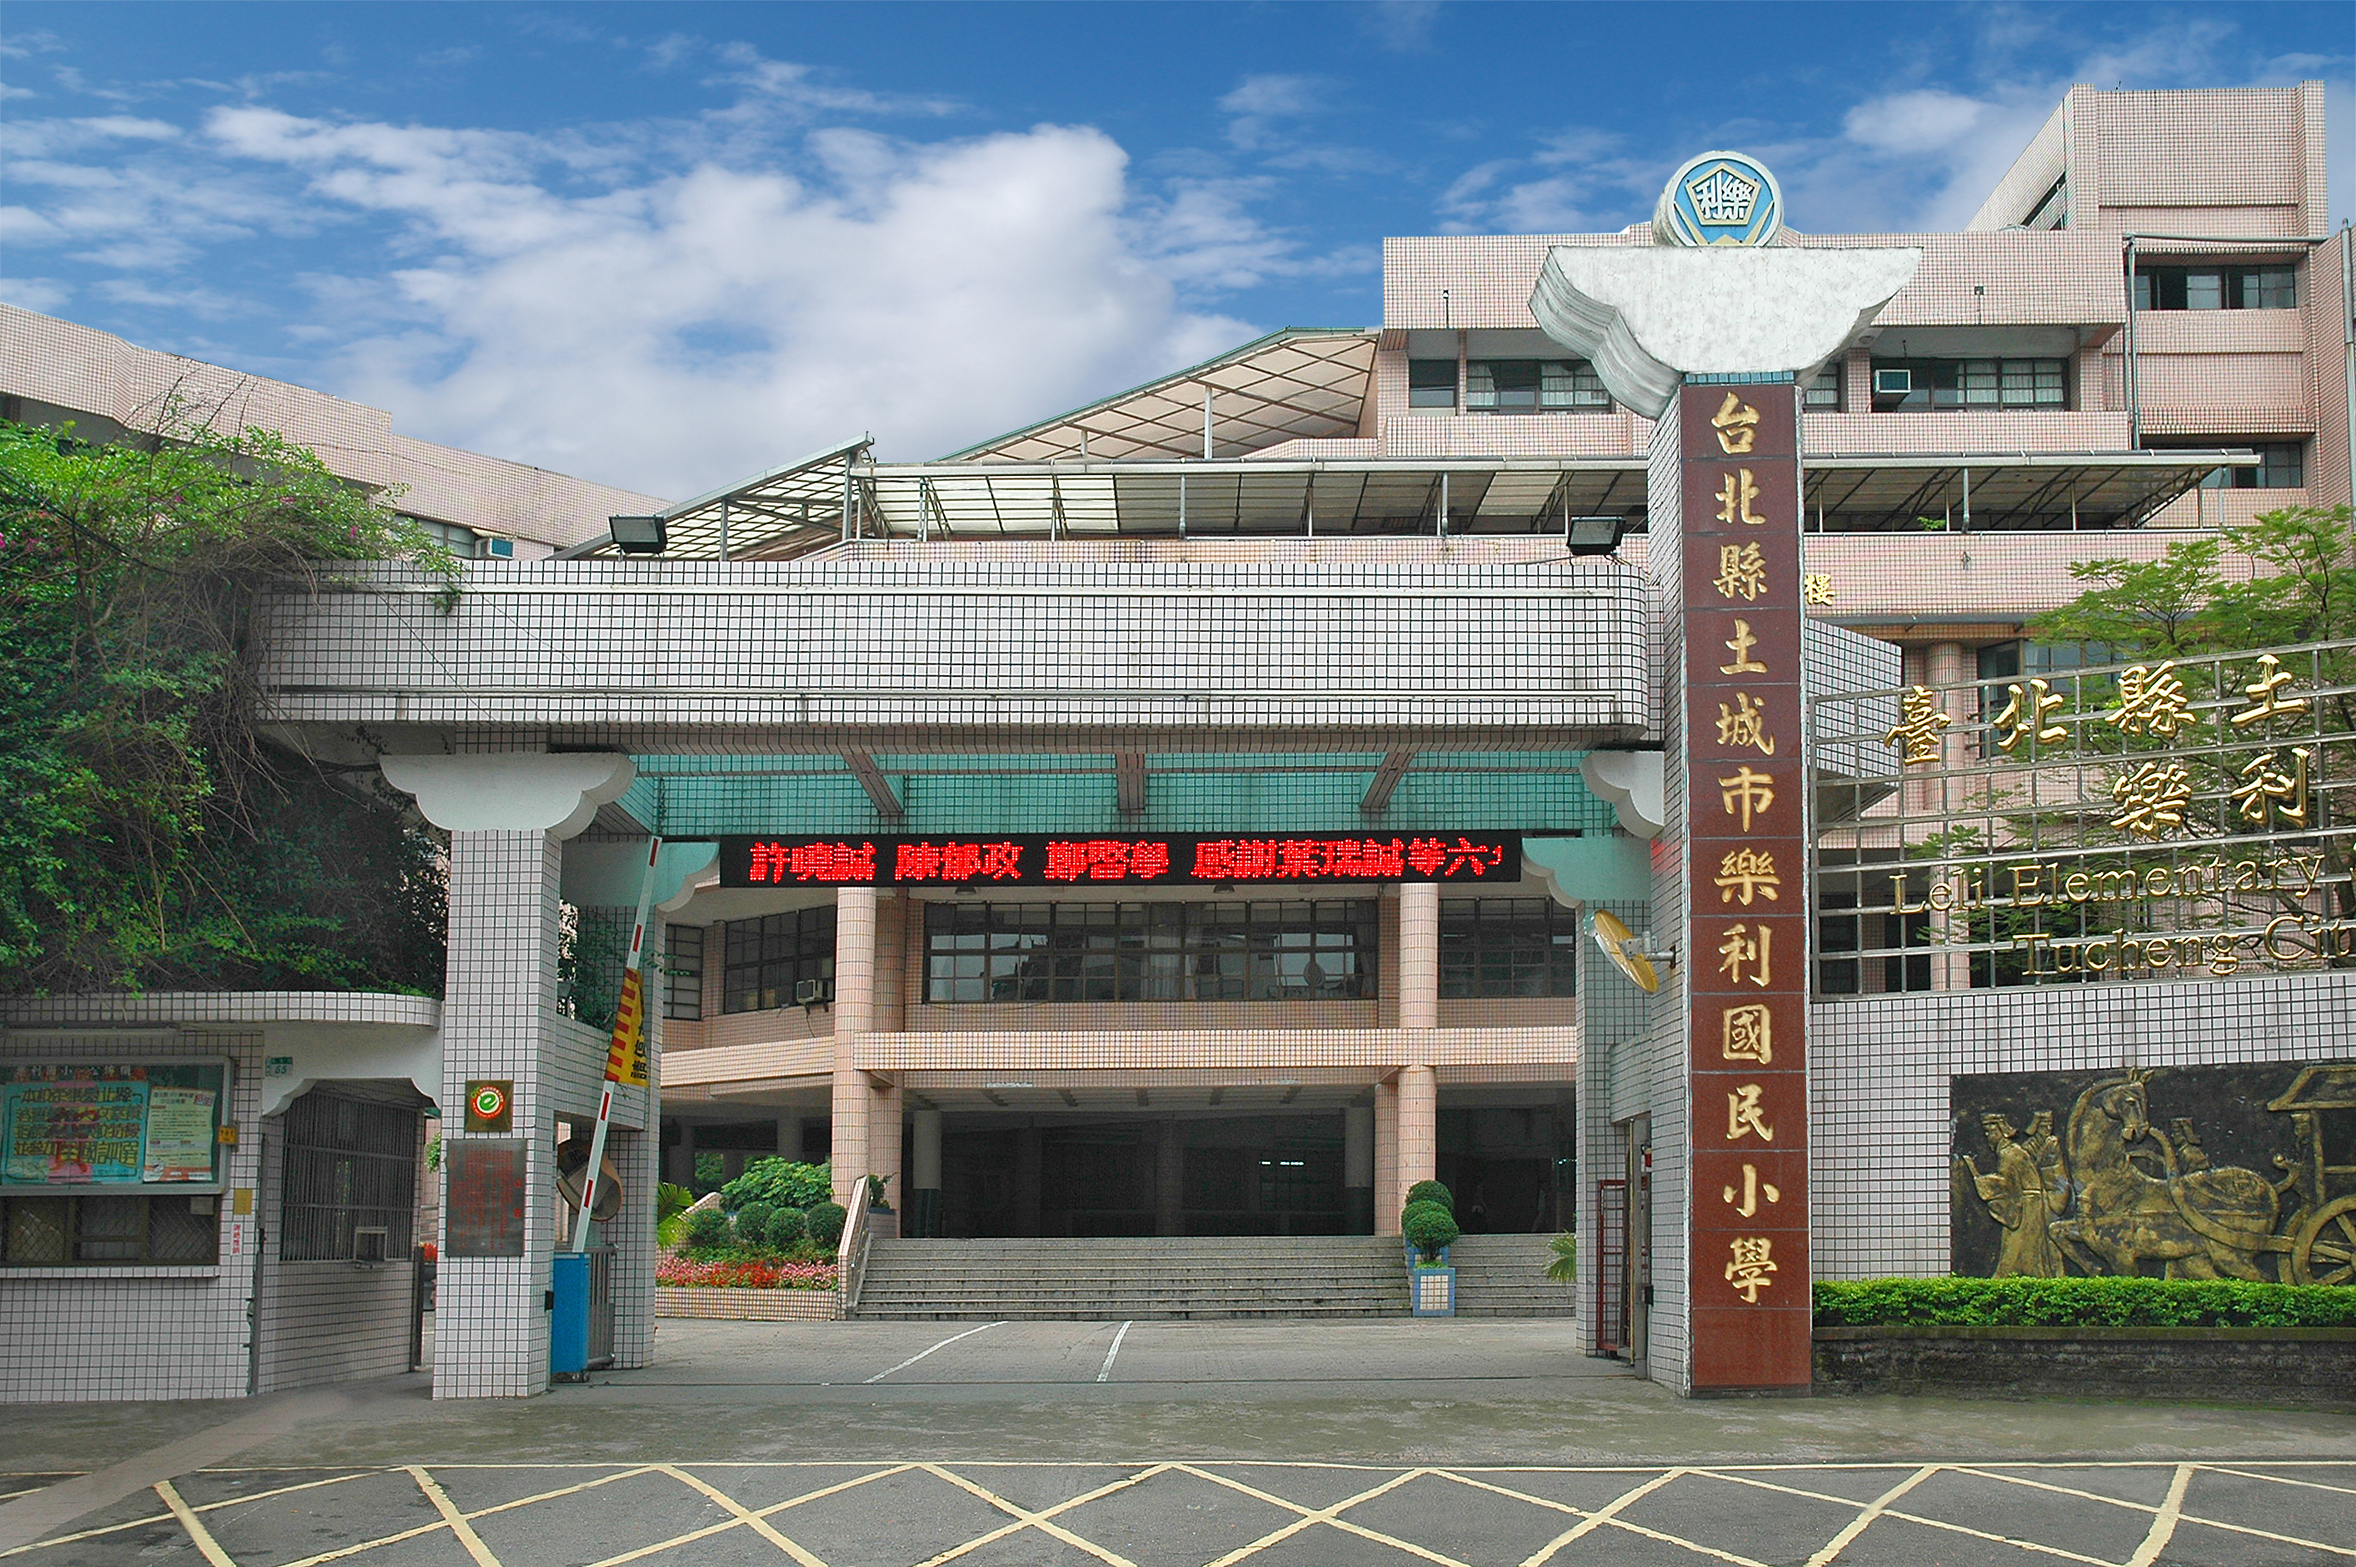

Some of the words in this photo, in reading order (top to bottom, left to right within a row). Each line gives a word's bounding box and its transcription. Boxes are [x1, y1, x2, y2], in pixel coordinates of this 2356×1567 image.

[1711, 391, 1780, 1304] 台北縣土城市樂利國民小學
[1889, 866, 1984, 916] Leli
[2007, 853, 2326, 909] Elementary
[2012, 928, 2240, 977] Tucheng
[2263, 914, 2356, 961] Cit
